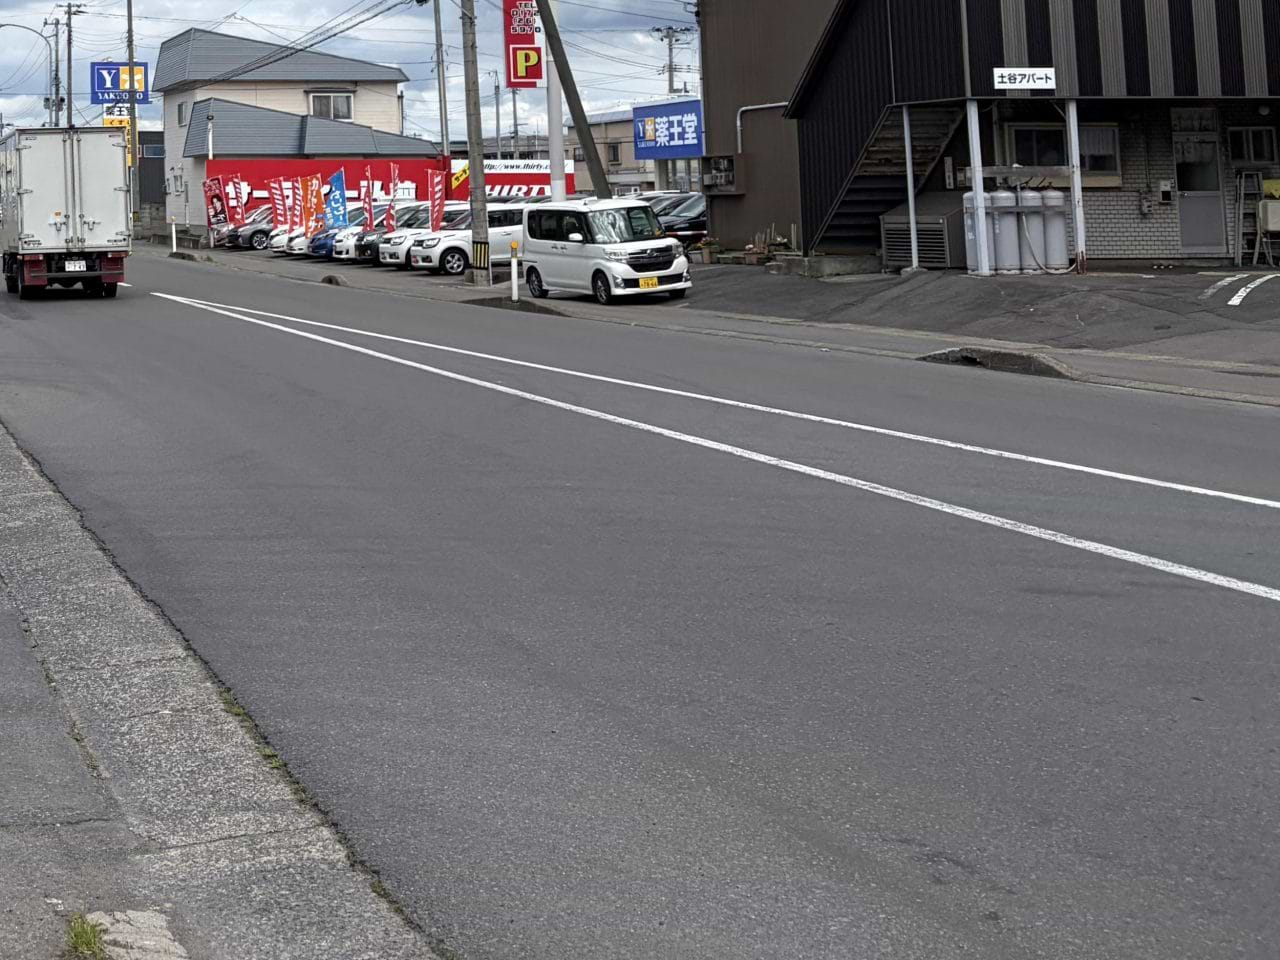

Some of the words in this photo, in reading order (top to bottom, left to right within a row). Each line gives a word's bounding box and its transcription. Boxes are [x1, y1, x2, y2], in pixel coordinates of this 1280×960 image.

[517, 1, 537, 9] TEL
[511, 9, 540, 17] 0172
[513, 17, 536, 25] (26)
[511, 26, 541, 34] 5970
[517, 49, 539, 77] P
[99, 69, 117, 89] Y
[98, 92, 144, 100] YAKUOO
[655, 113, 699, 148] 薬王堂
